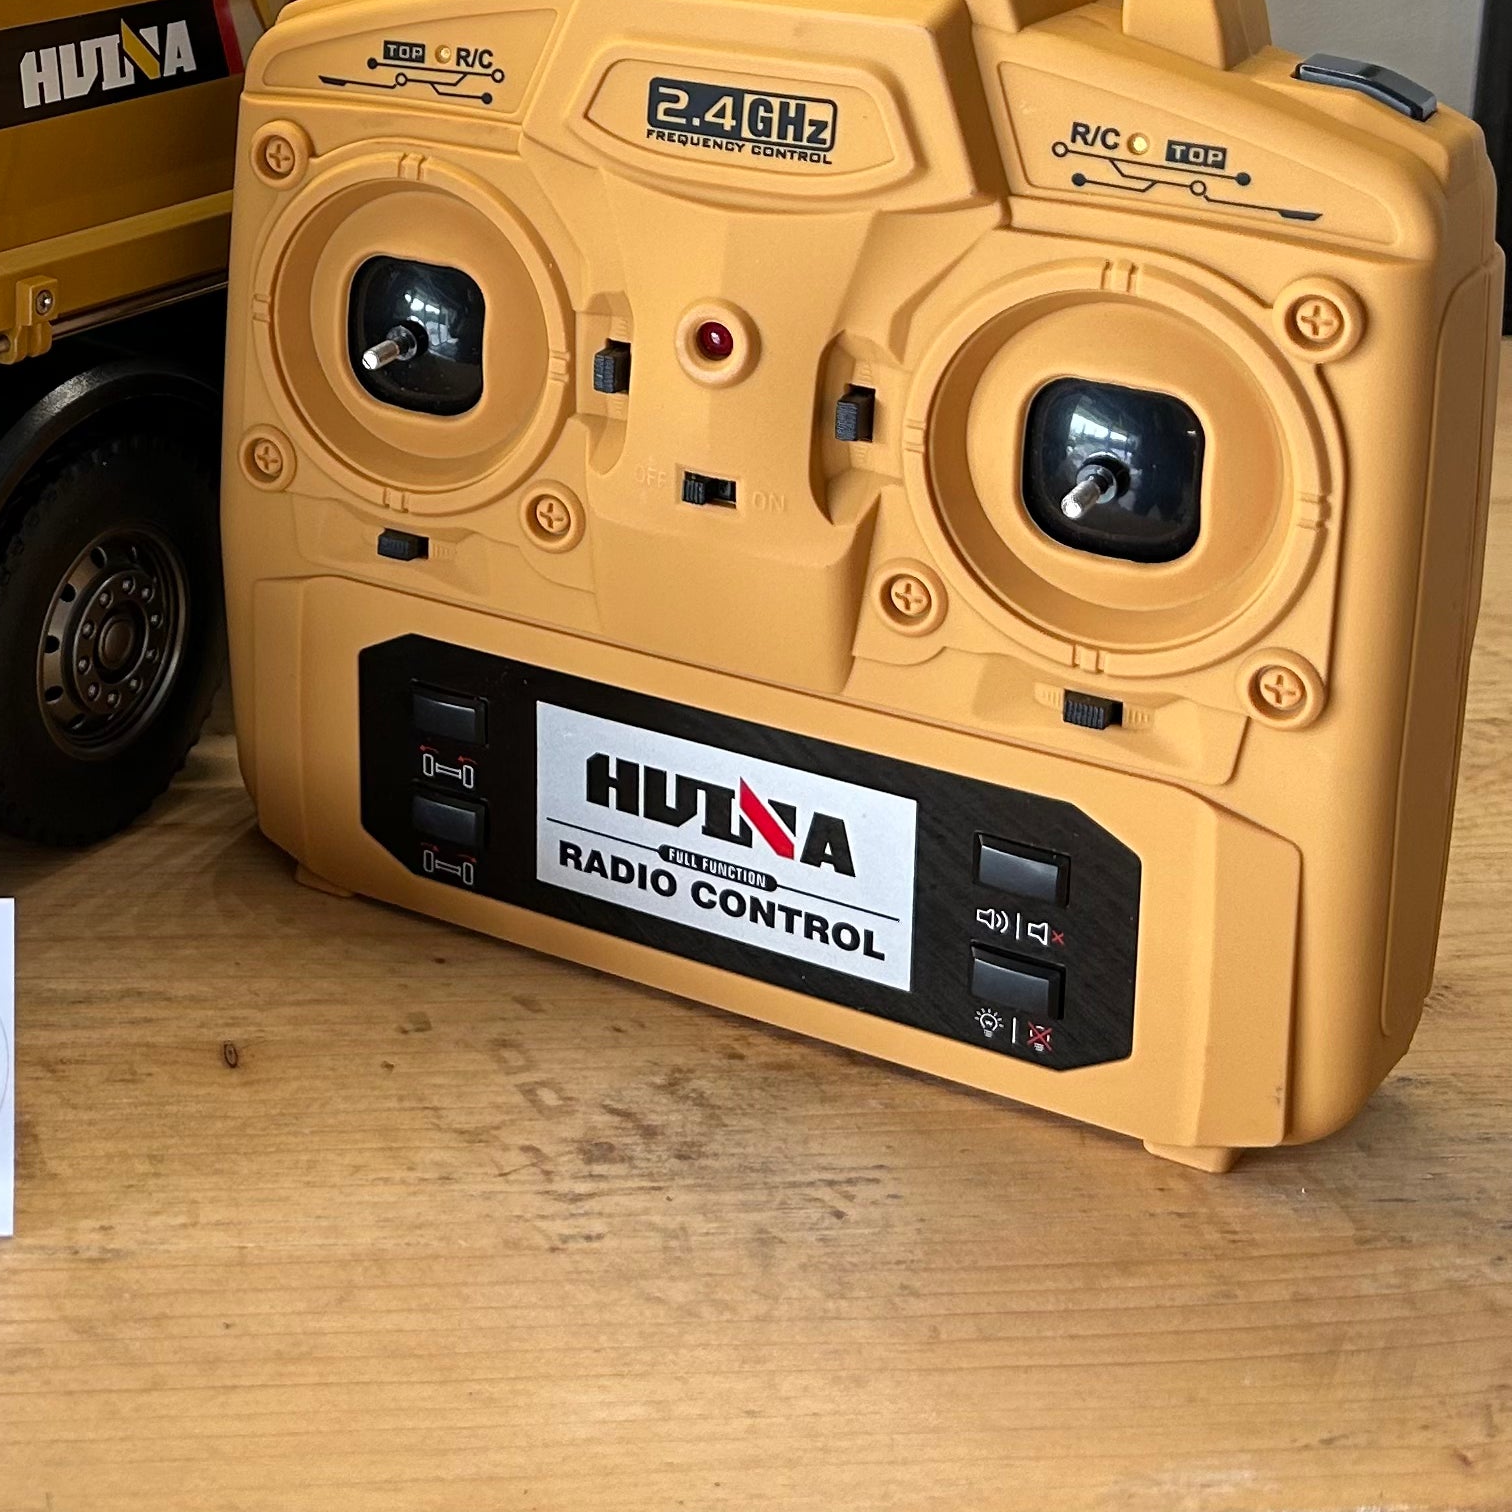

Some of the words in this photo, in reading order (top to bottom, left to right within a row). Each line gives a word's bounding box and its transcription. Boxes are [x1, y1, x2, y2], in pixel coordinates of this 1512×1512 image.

[20, 19, 197, 109] HUINA
[386, 43, 424, 62] TOP
[455, 46, 494, 70] R/C
[646, 128, 746, 154] FREQUENCY
[751, 143, 833, 165] CONTROL
[1070, 121, 1121, 150] R/C
[1170, 144, 1224, 165] TOP
[752, 492, 785, 512] ON
[586, 751, 856, 878] HUINA
[668, 847, 698, 869] FULL
[702, 857, 767, 888] FUNCTION
[559, 839, 677, 897] RADIO
[691, 880, 886, 961] CONTROL
